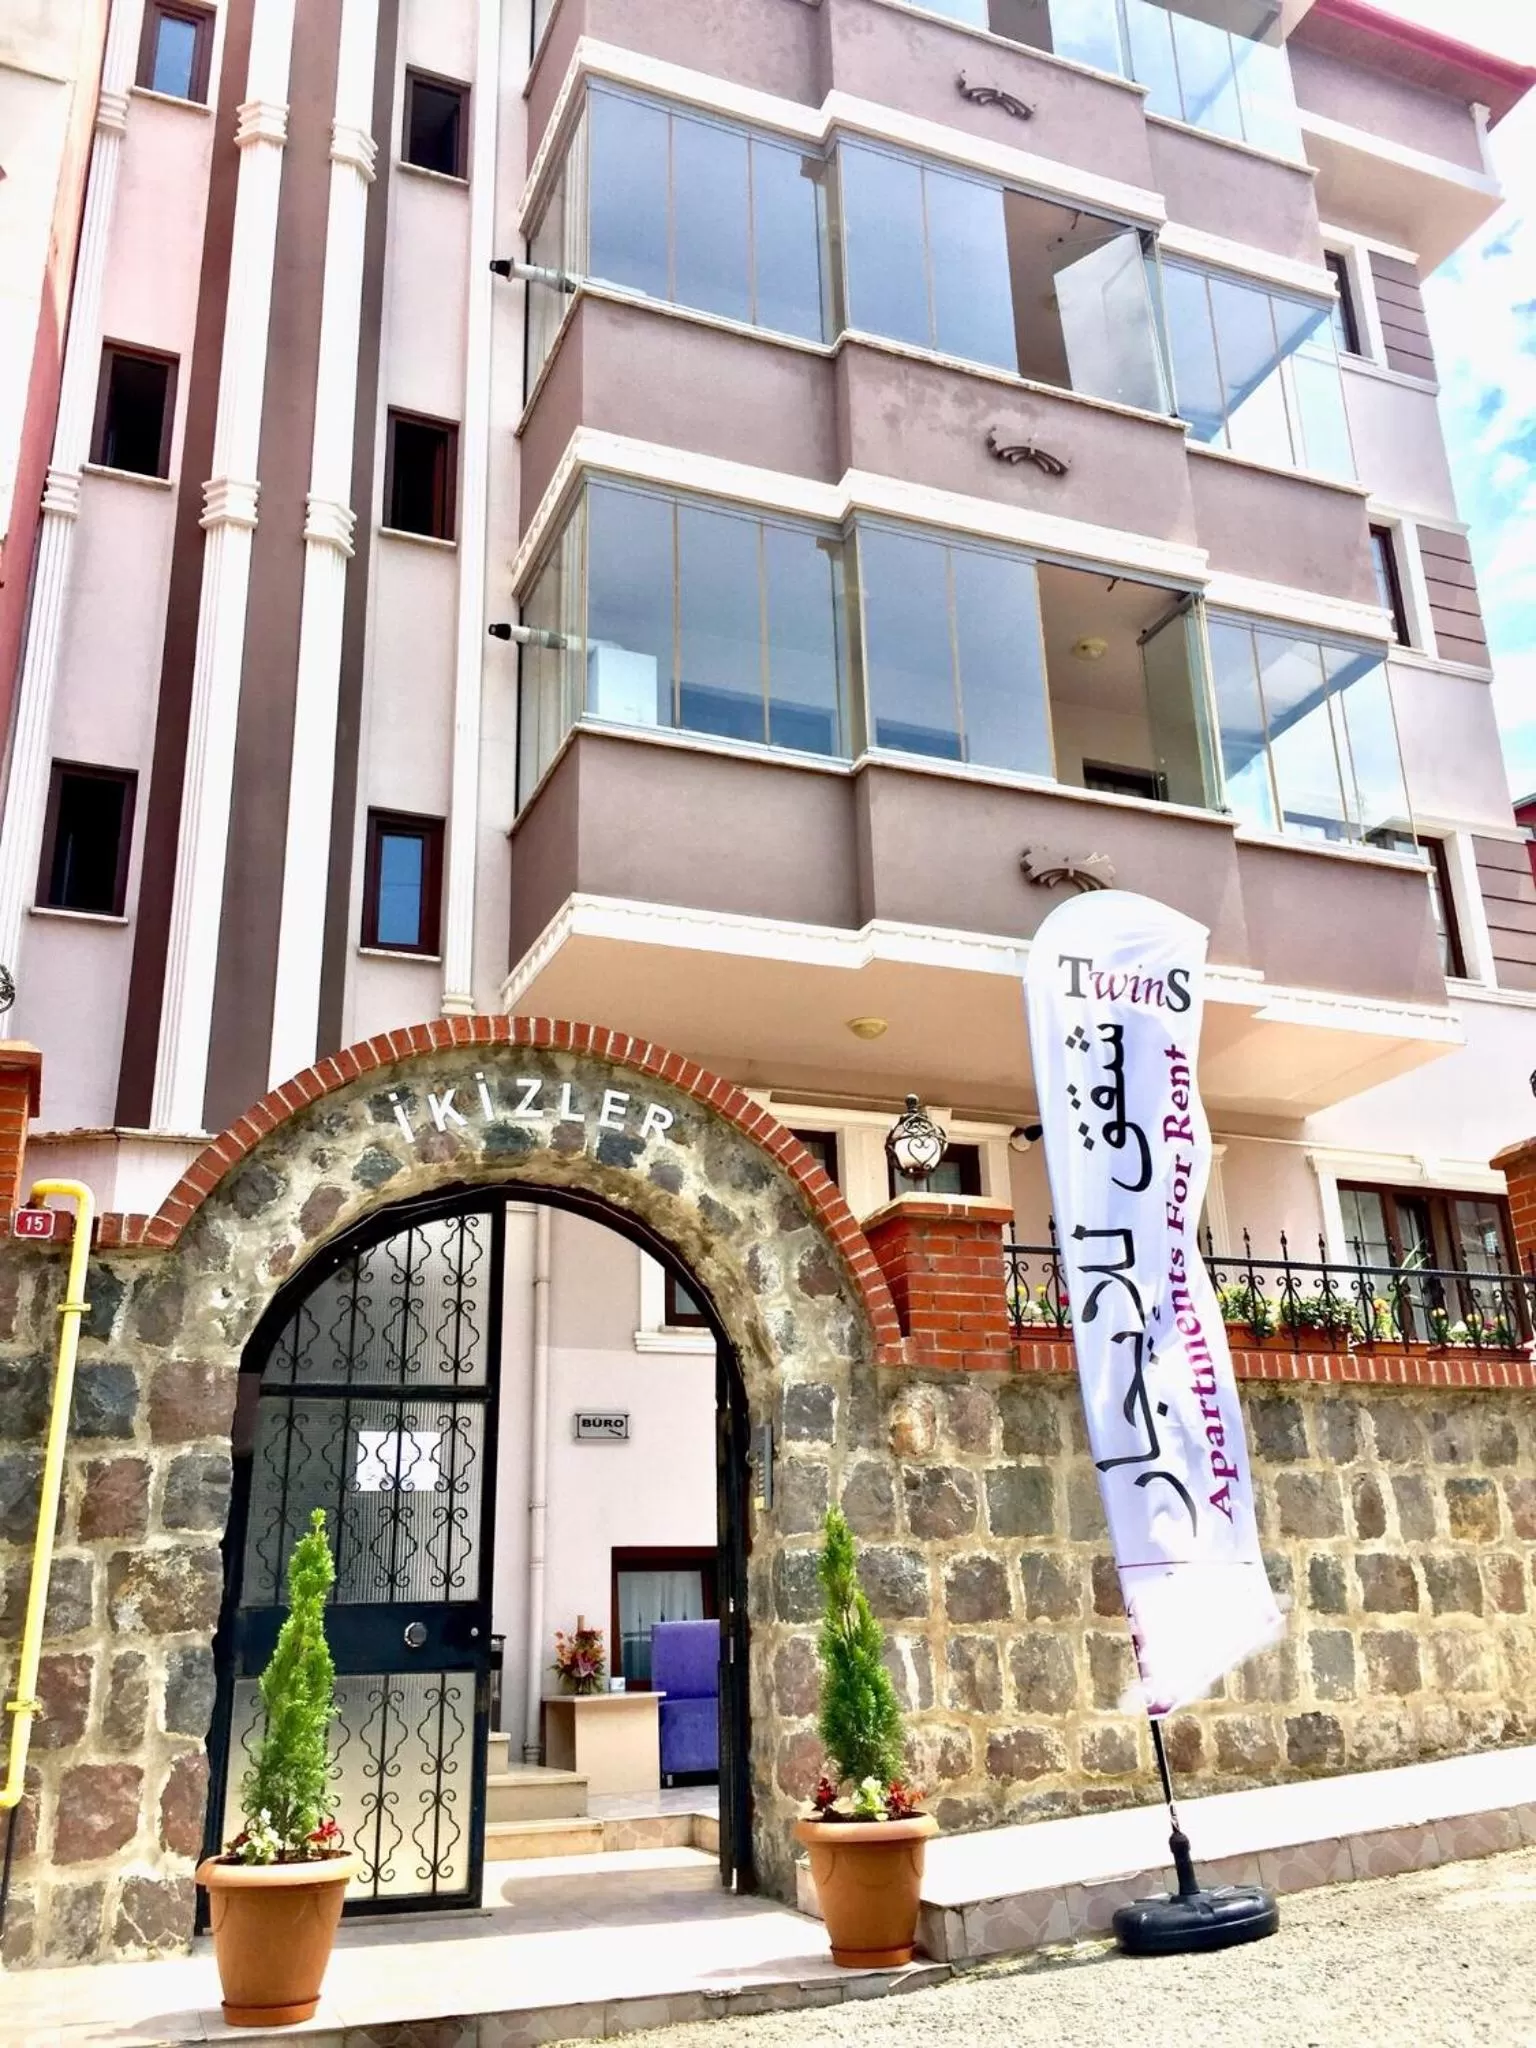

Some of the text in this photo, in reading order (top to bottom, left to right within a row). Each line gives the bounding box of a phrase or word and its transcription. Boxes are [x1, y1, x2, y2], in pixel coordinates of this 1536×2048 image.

[1058, 954, 1191, 1013] TwinS
[388, 1071, 675, 1145] İKİZLER
[1065, 1022, 1153, 1192] شقق
[26, 1216, 44, 1231] 15
[1162, 1043, 1240, 1524] Apartments For Rent
[581, 1416, 624, 1428] BÜRO
